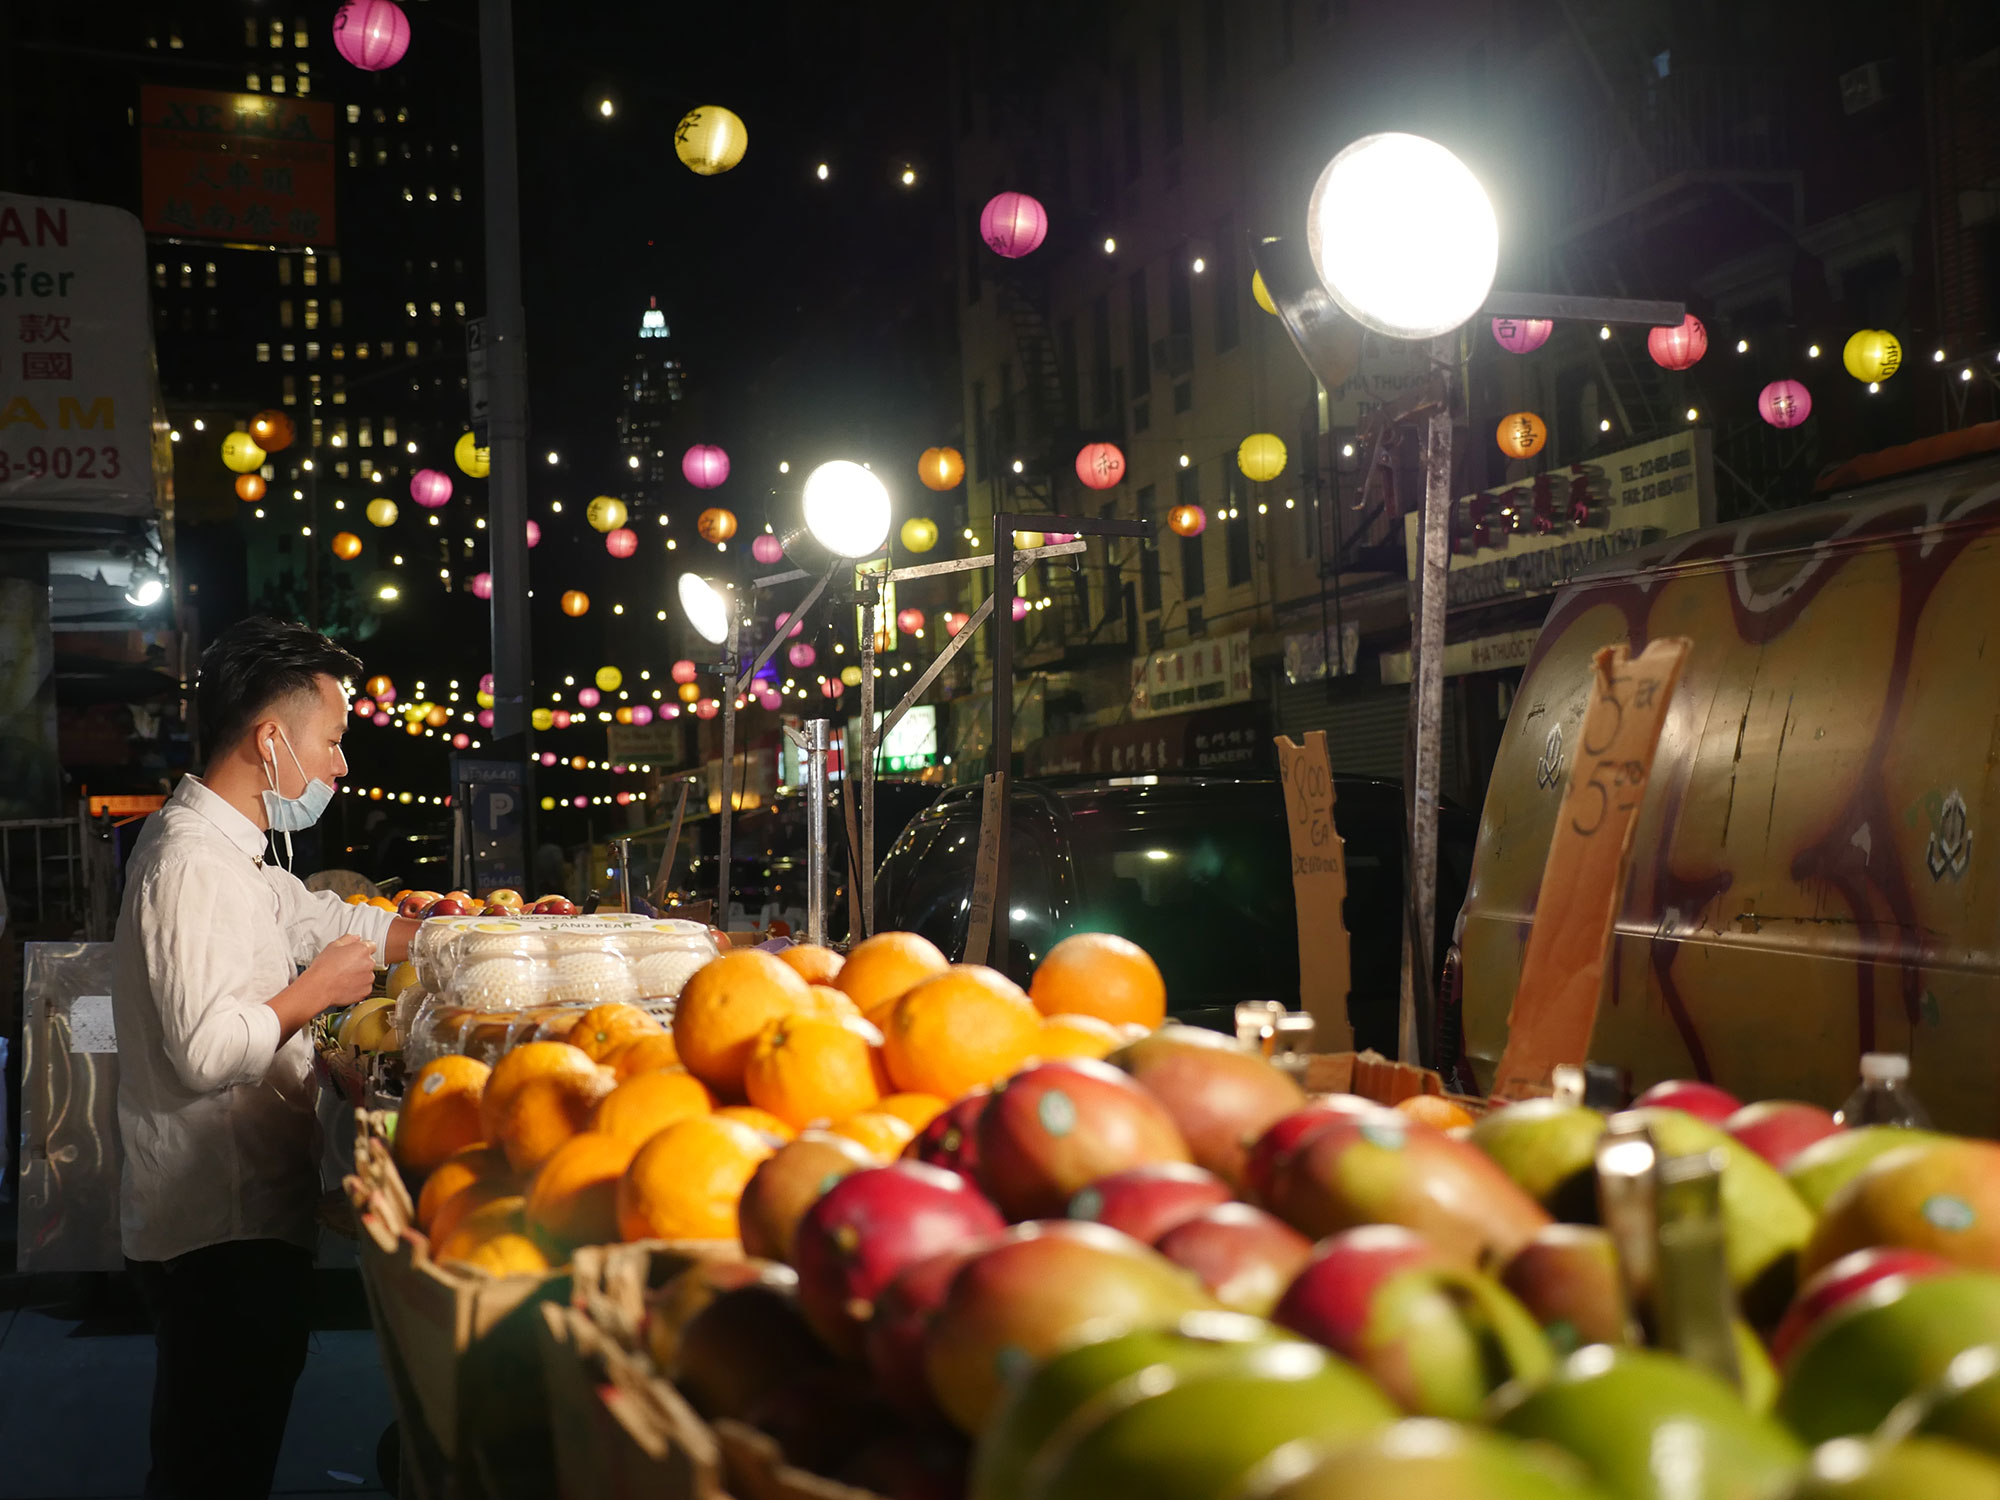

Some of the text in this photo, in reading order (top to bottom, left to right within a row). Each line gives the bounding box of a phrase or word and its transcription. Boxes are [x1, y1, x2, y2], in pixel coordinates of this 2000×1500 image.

[0, 207, 69, 247] AN
[18, 314, 71, 343] 款
[23, 352, 73, 380] 國
[0, 395, 115, 430] AM
[489, 792, 514, 831] P
[595, 921, 632, 929] PEAR
